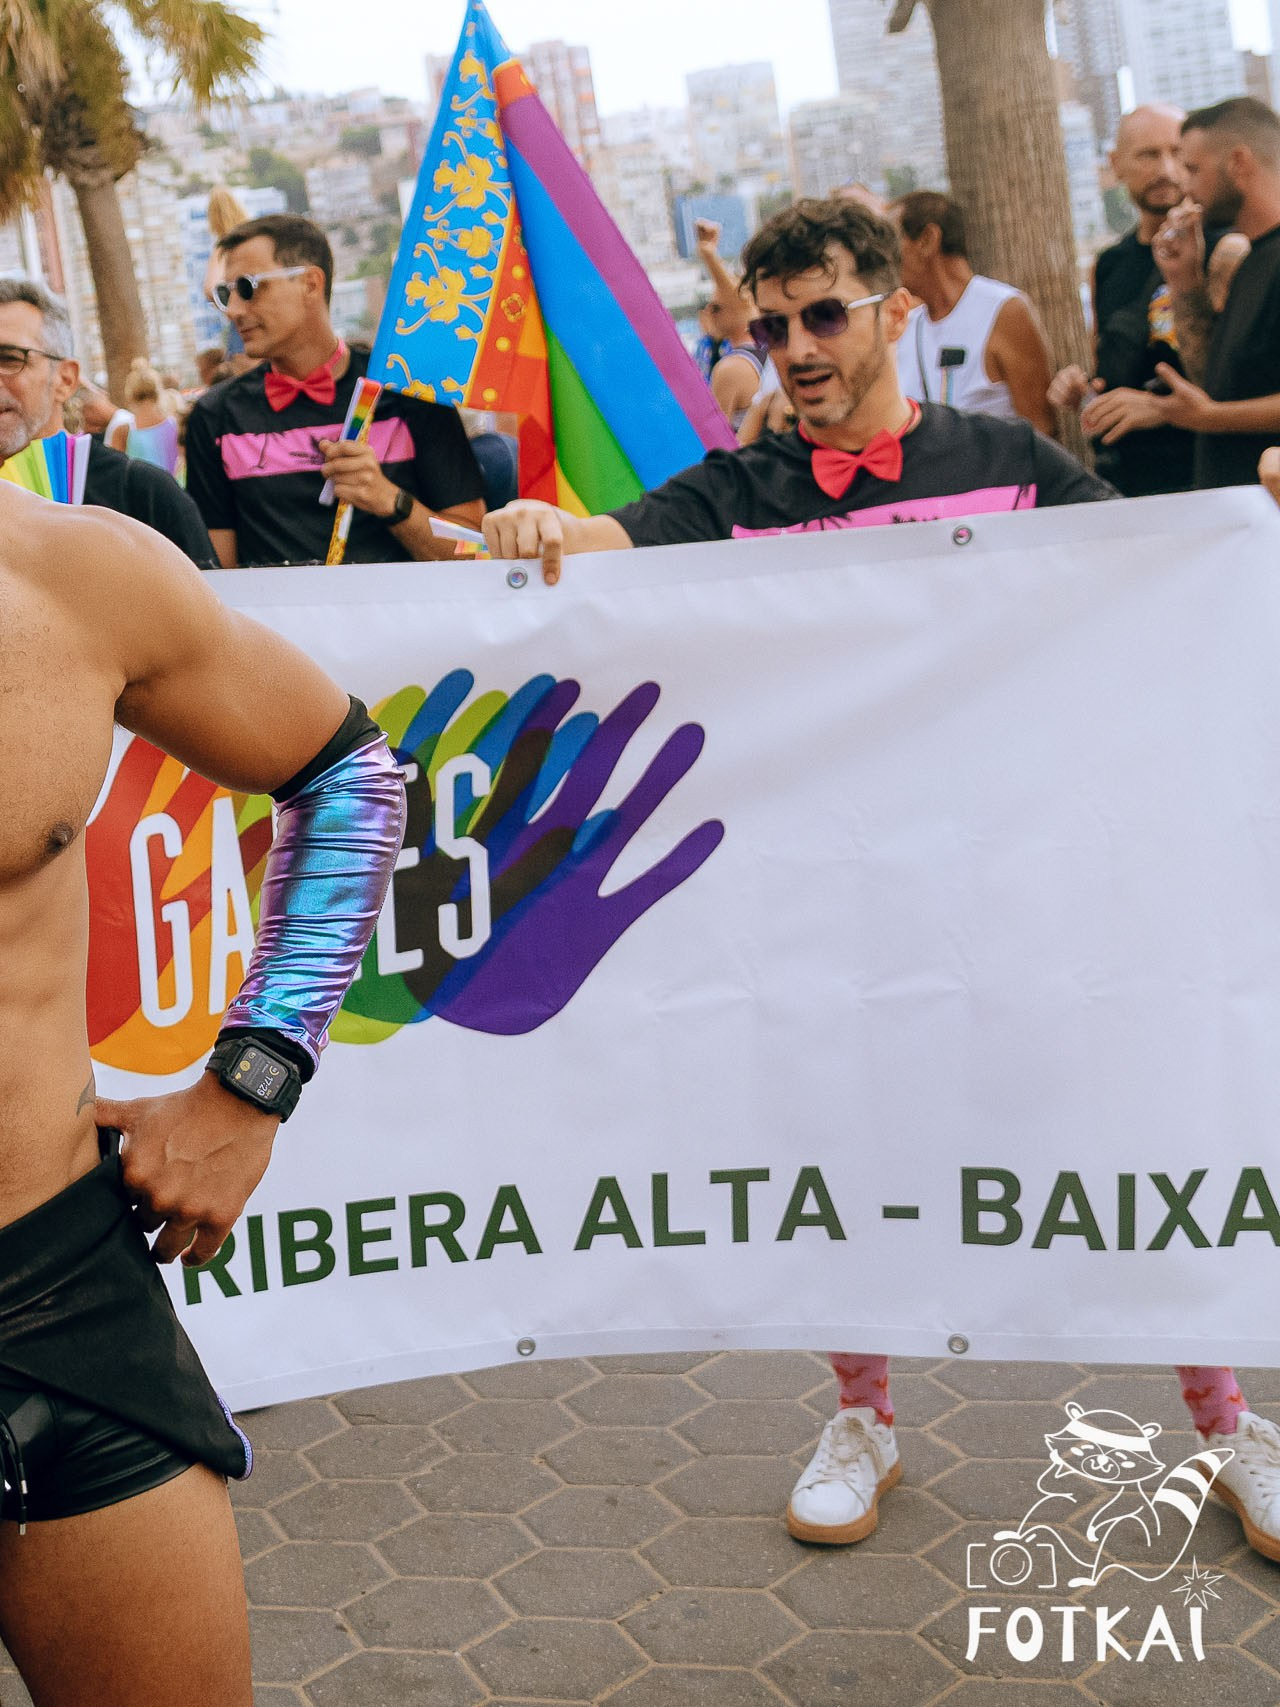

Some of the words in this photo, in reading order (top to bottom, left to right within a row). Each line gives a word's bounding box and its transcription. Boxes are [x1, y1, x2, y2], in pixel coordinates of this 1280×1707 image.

[256, 1076, 274, 1097] 17:29
[182, 1184, 544, 1306] RIBERA
[573, 1165, 848, 1251] ALTA
[960, 1166, 1280, 1251] BAIXA
